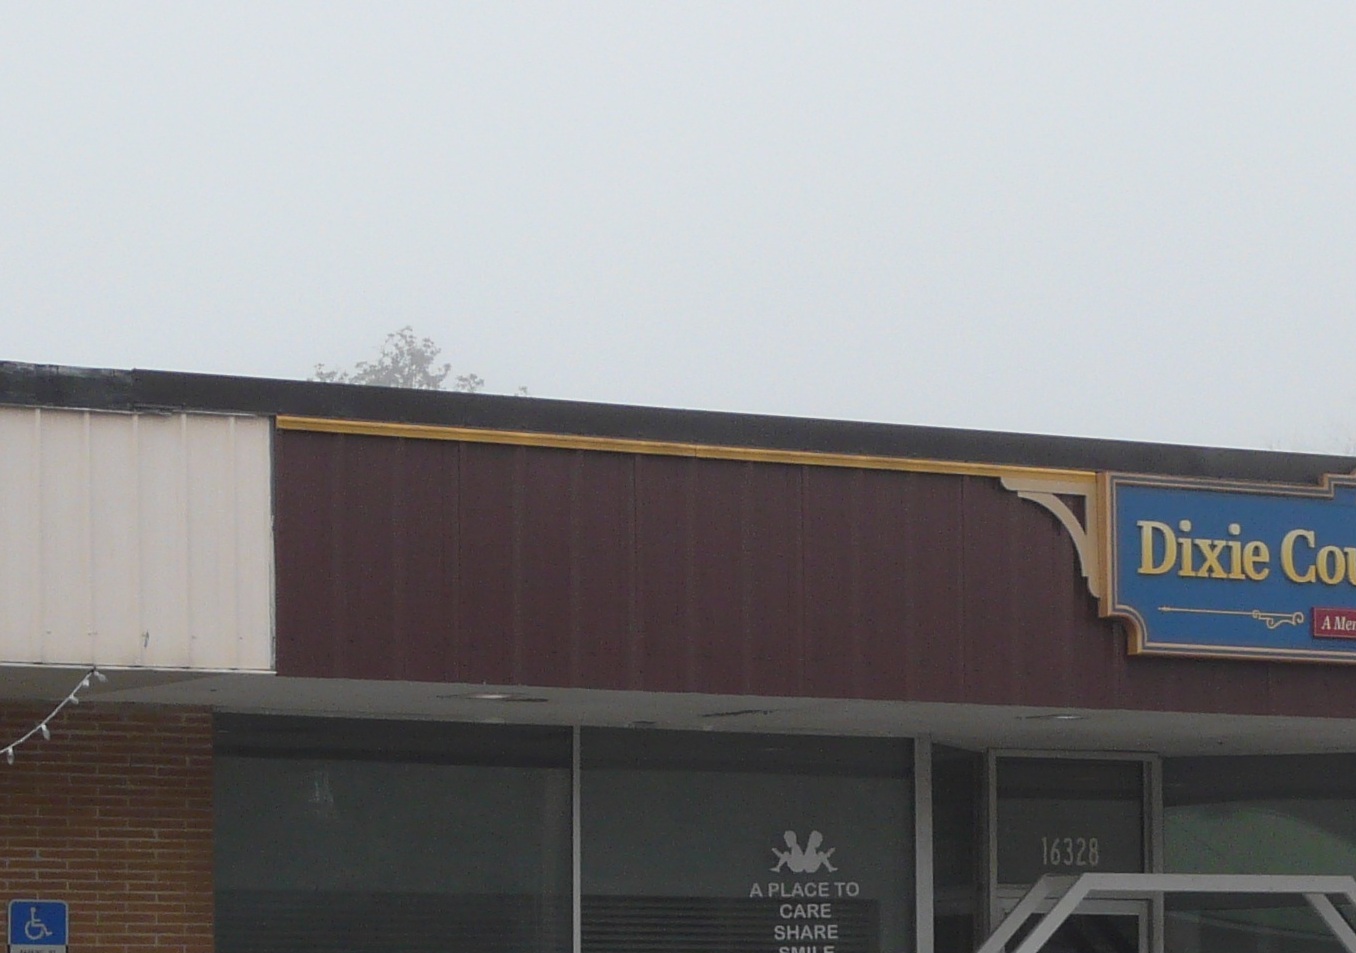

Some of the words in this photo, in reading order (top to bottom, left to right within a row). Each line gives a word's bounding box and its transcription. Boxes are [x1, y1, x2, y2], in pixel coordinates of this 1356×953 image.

[1136, 519, 1270, 582] Dixie
[1321, 616, 1332, 631] A
[1041, 836, 1099, 866] 16328
[749, 883, 763, 898] A
[767, 882, 830, 898] PLACE
[834, 882, 860, 897] TO
[779, 903, 832, 919] CARE
[773, 924, 839, 941] SHARE
